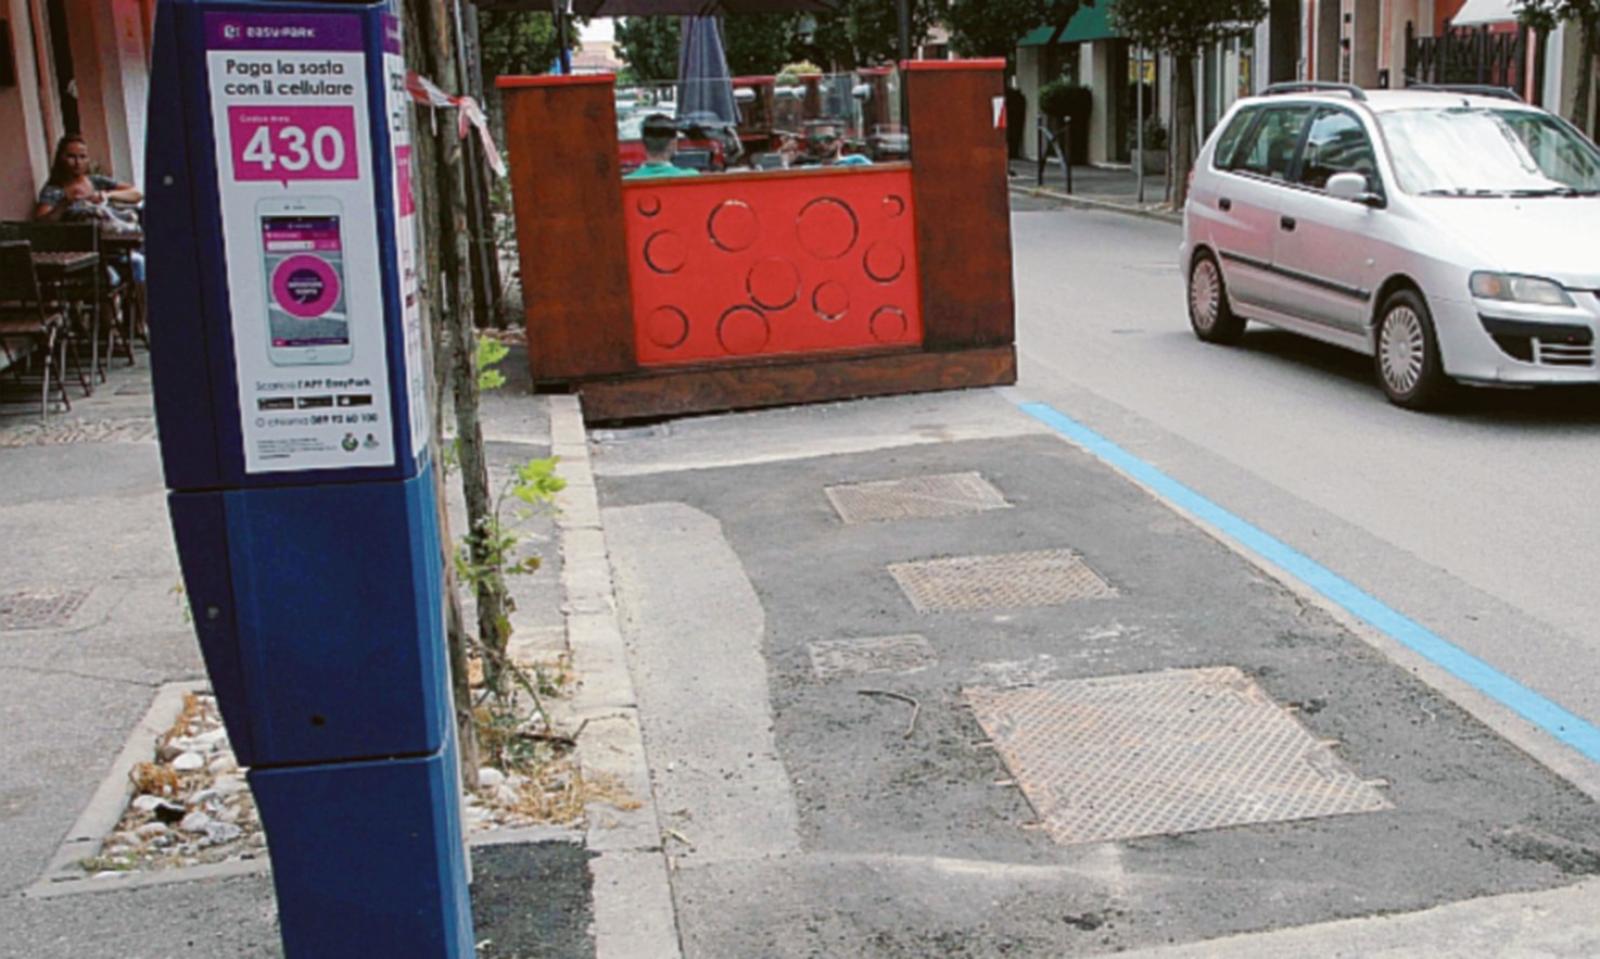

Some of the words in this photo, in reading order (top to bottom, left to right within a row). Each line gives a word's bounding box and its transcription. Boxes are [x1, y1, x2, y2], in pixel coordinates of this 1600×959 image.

[226, 59, 273, 77] Paga
[277, 59, 295, 75] la
[299, 60, 344, 75] sosta
[224, 82, 260, 96] con
[263, 80, 273, 95] il
[277, 80, 354, 96] cellulare
[242, 125, 345, 172] 430
